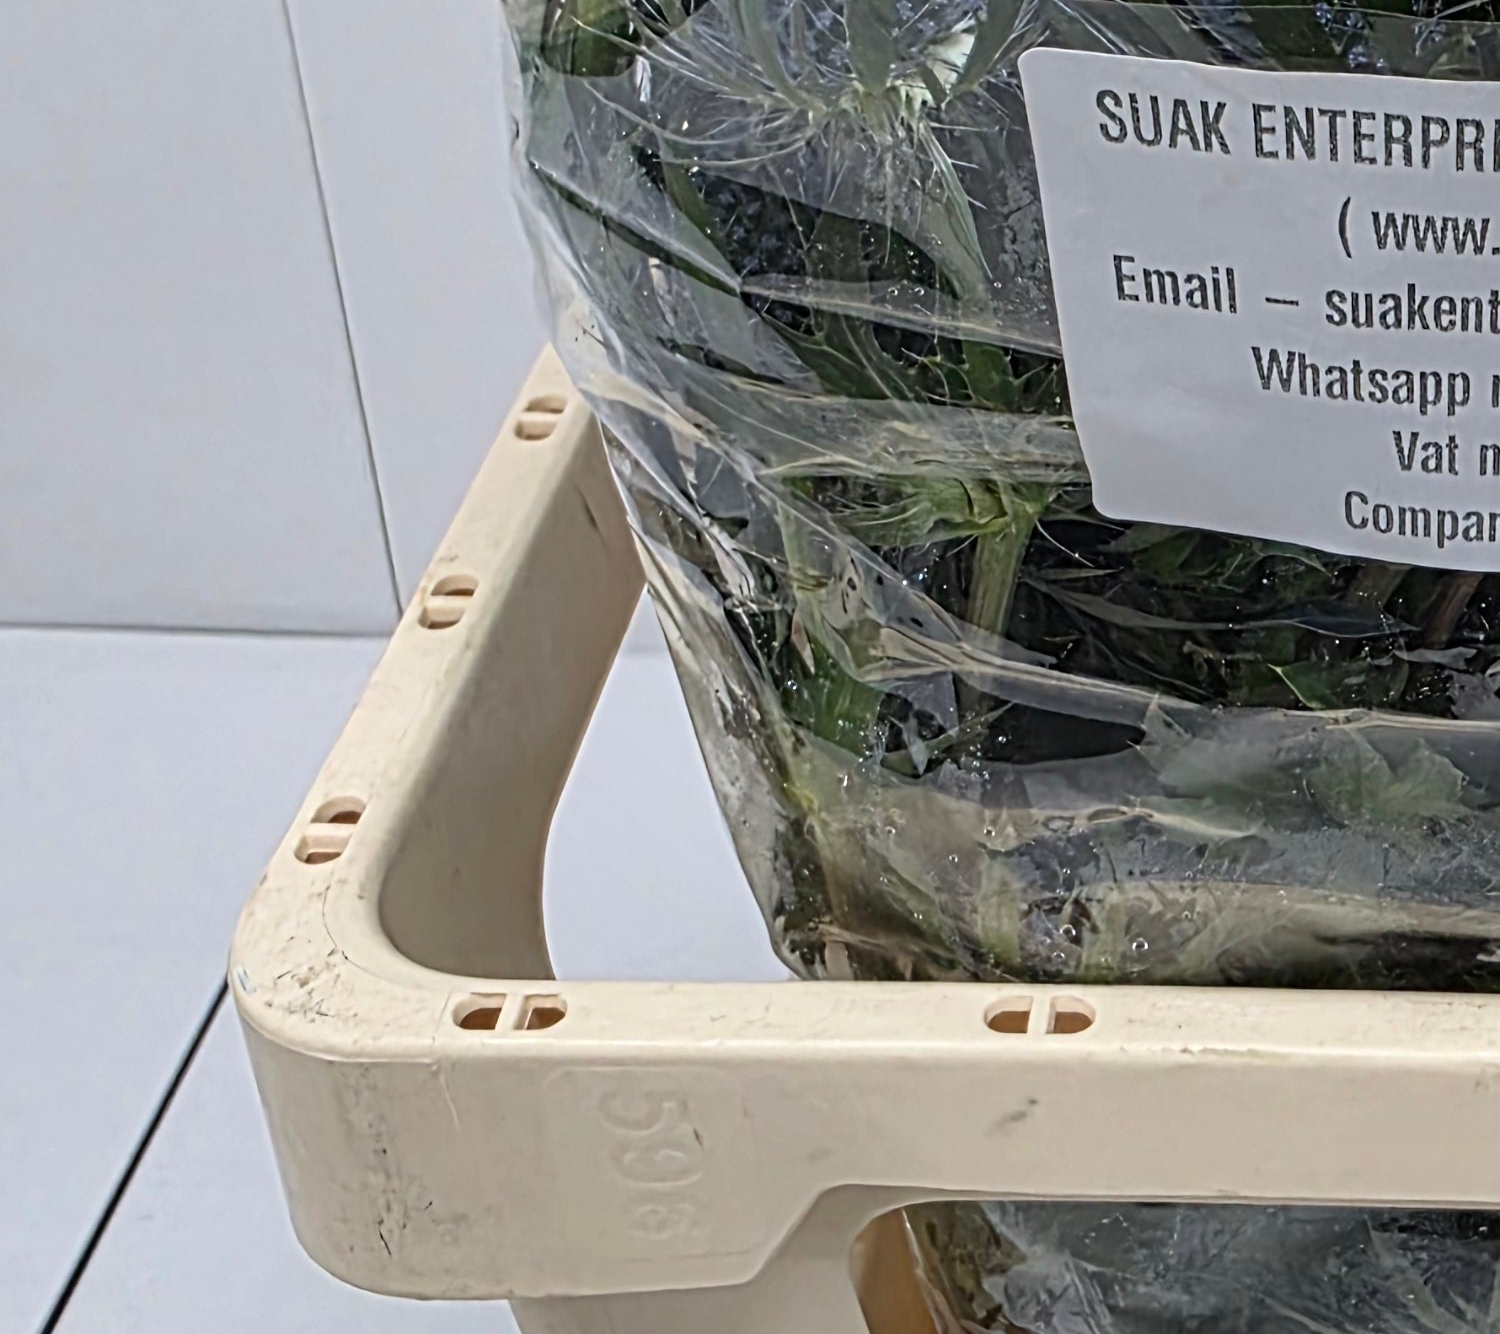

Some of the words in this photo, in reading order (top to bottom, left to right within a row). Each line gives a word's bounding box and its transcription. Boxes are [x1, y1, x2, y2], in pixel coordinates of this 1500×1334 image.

[1095, 89, 1232, 156] SUAK
[1112, 253, 1238, 315] Email
[1250, 345, 1471, 418] Whatsapp
[1391, 429, 1460, 477] Vat
